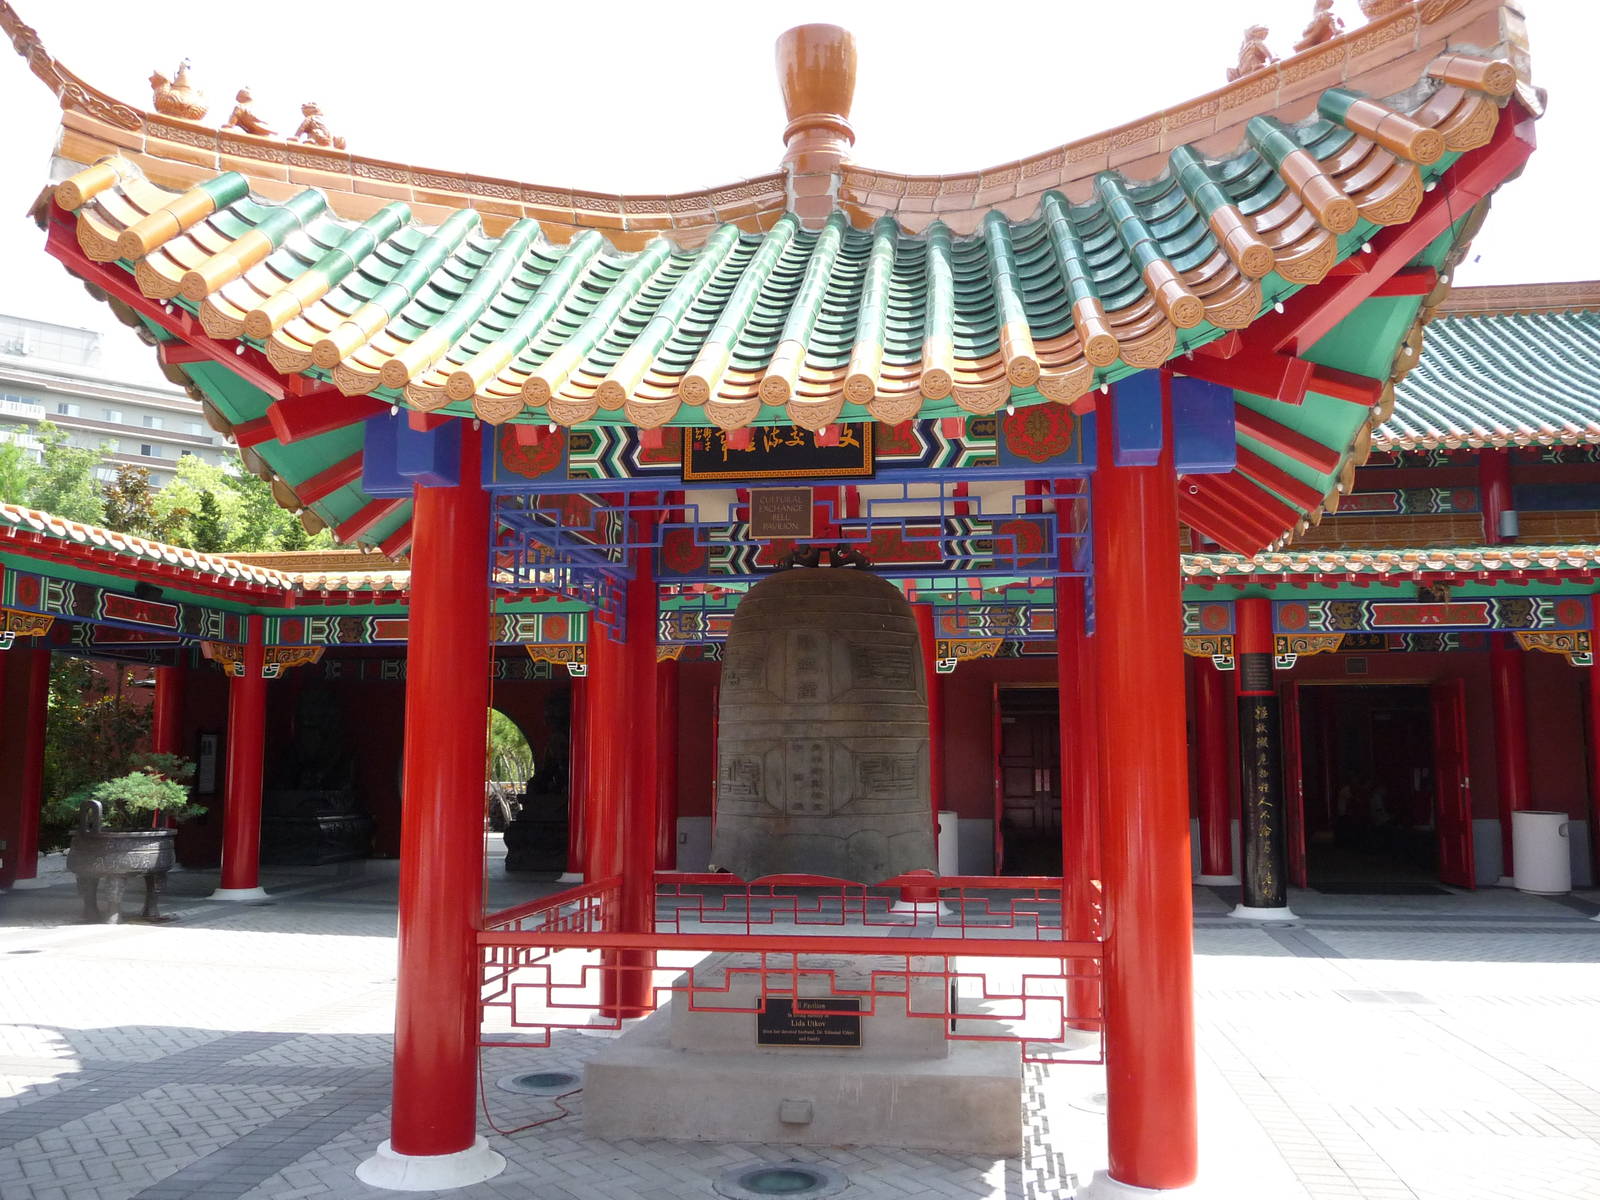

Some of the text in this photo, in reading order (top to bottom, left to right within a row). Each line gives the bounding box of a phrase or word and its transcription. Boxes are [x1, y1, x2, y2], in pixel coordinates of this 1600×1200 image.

[759, 495, 803, 504] CULTURAL
[759, 504, 804, 513] EXCHANGE
[772, 512, 791, 521] BELL
[762, 520, 799, 530] PAVILION
